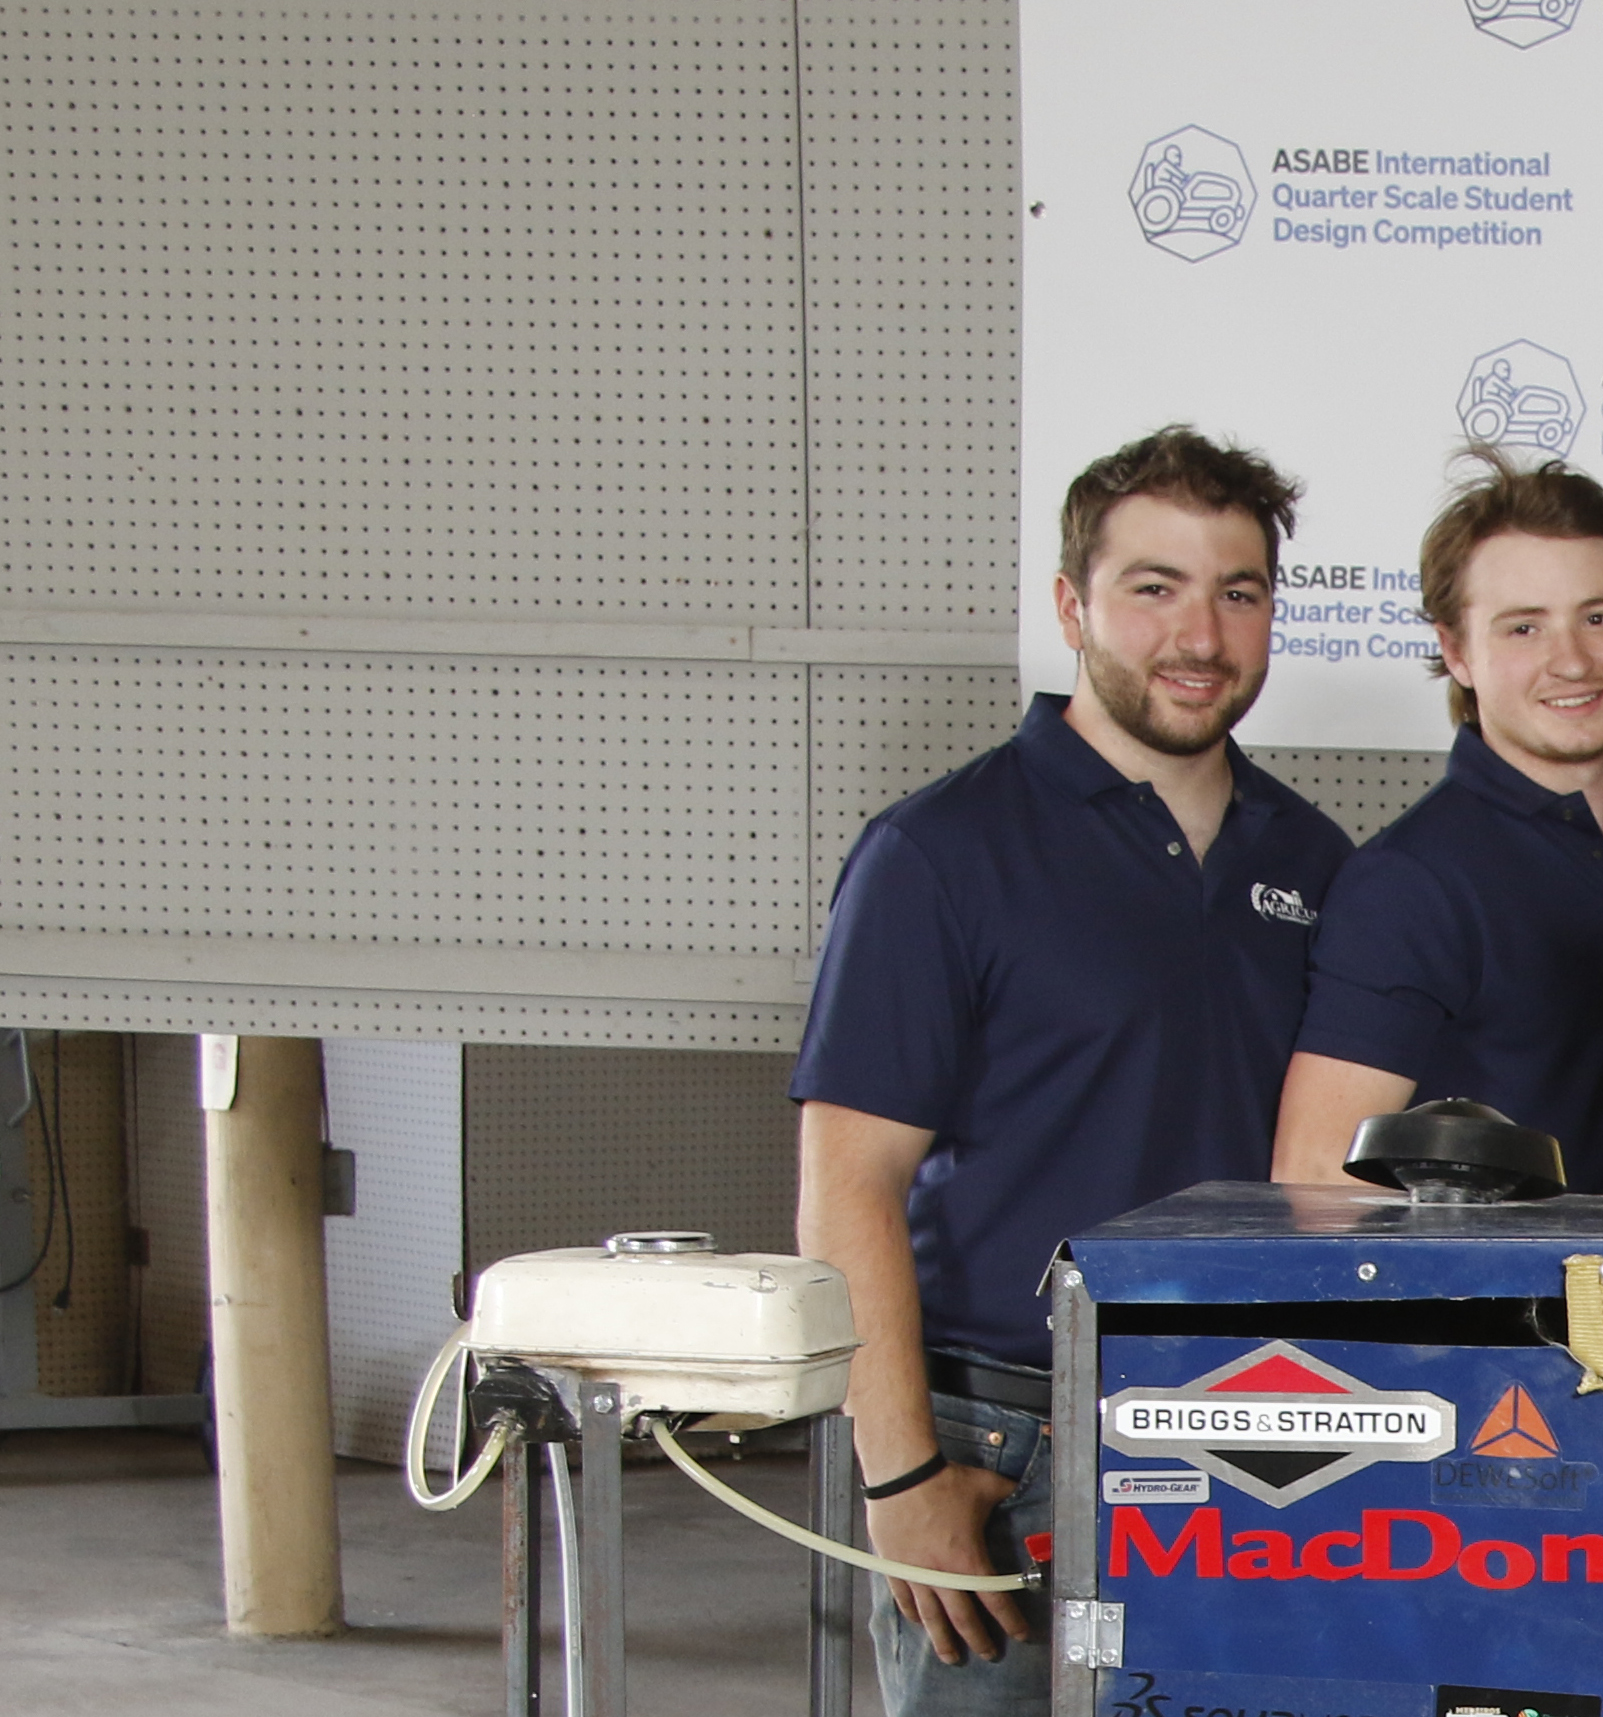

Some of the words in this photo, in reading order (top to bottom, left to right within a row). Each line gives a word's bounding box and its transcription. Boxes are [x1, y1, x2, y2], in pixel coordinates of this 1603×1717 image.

[1272, 148, 1370, 175] ASABE
[1376, 150, 1550, 177] International
[1272, 182, 1378, 211] Quarter
[1384, 184, 1459, 210] Scale
[1464, 185, 1573, 211] Student
[1273, 217, 1366, 249] Design
[1373, 218, 1542, 250] Competition
[1275, 564, 1366, 590] ASABE
[1272, 598, 1373, 626] Quarter
[1270, 631, 1360, 663] Design
[1133, 1483, 1197, 1493] HYDRO-GEAR
